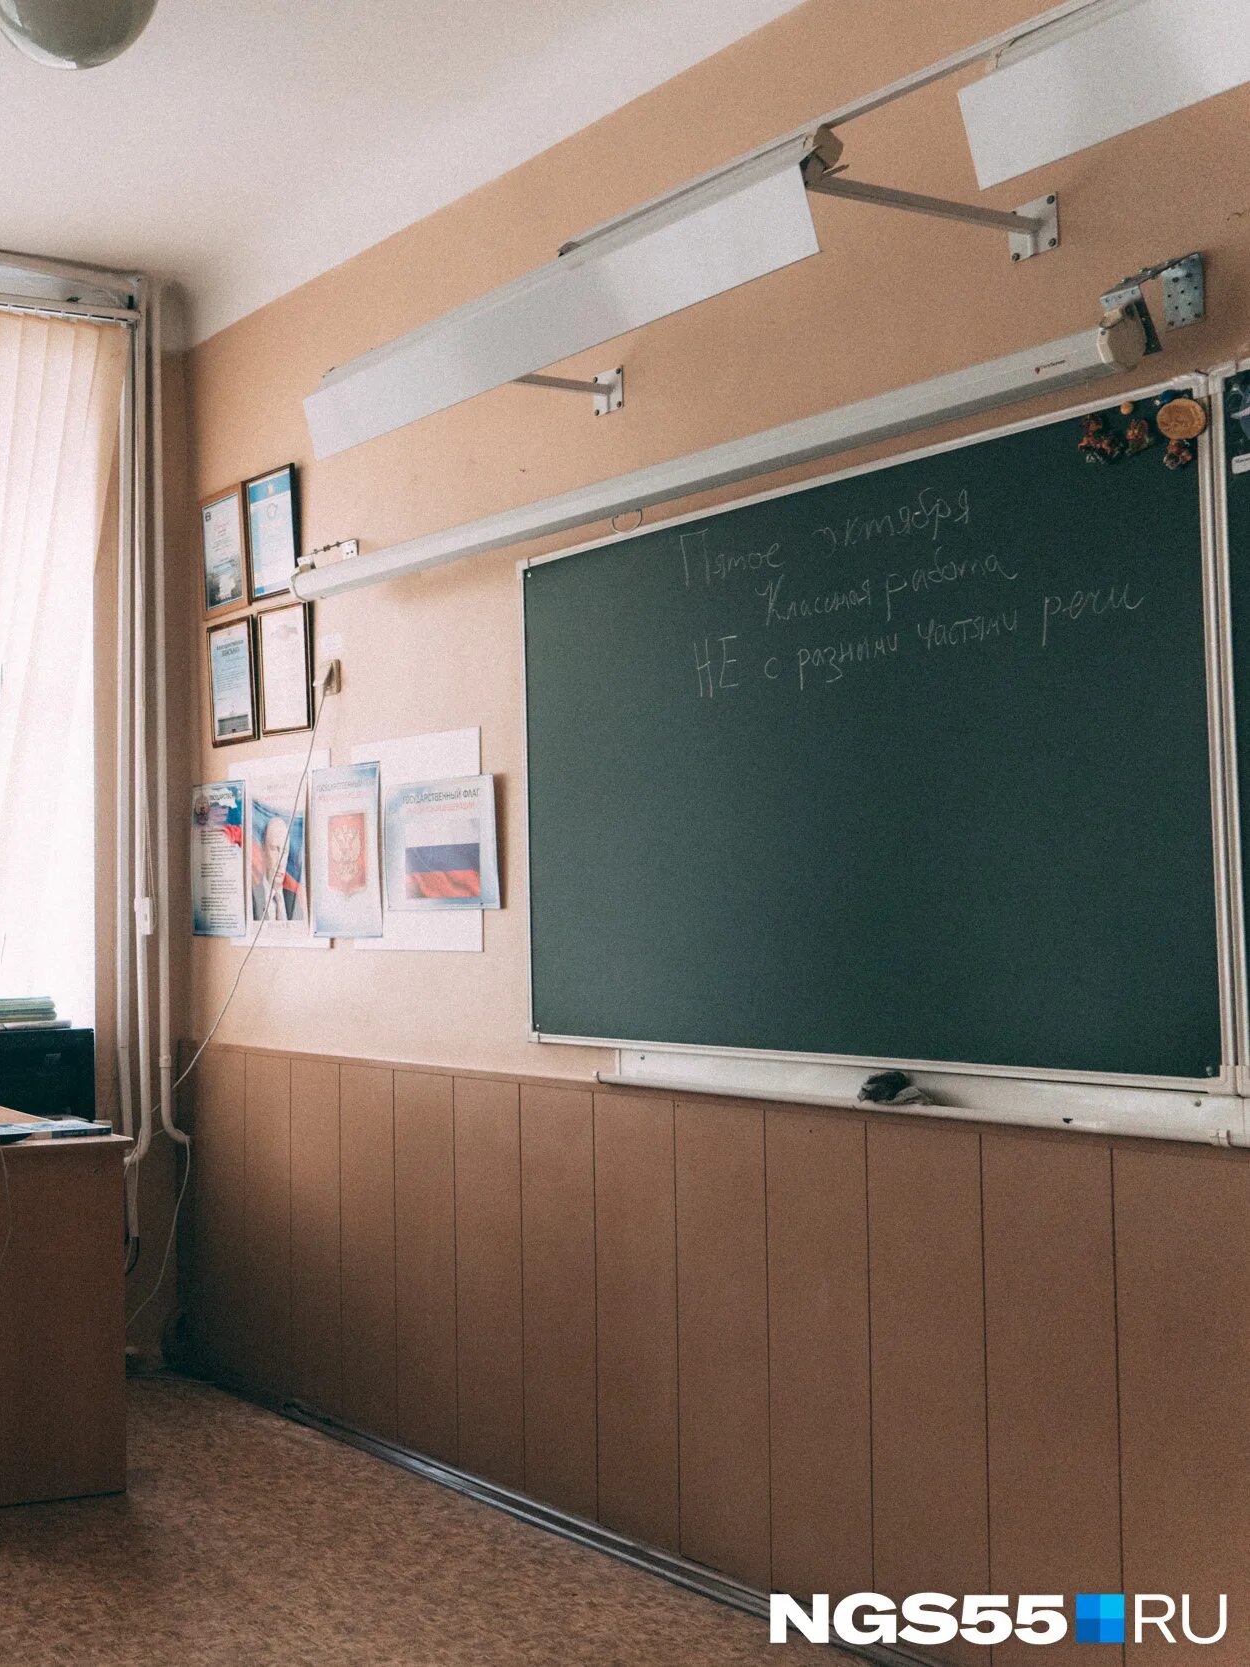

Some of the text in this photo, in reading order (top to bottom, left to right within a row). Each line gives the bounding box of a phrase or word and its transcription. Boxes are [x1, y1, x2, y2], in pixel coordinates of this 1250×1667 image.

[679, 528, 786, 587] Пятое
[885, 546, 1019, 622] работа
[693, 583, 1145, 698] НЕ с разными частями речи
[462, 787, 481, 798] ФЛАГ
